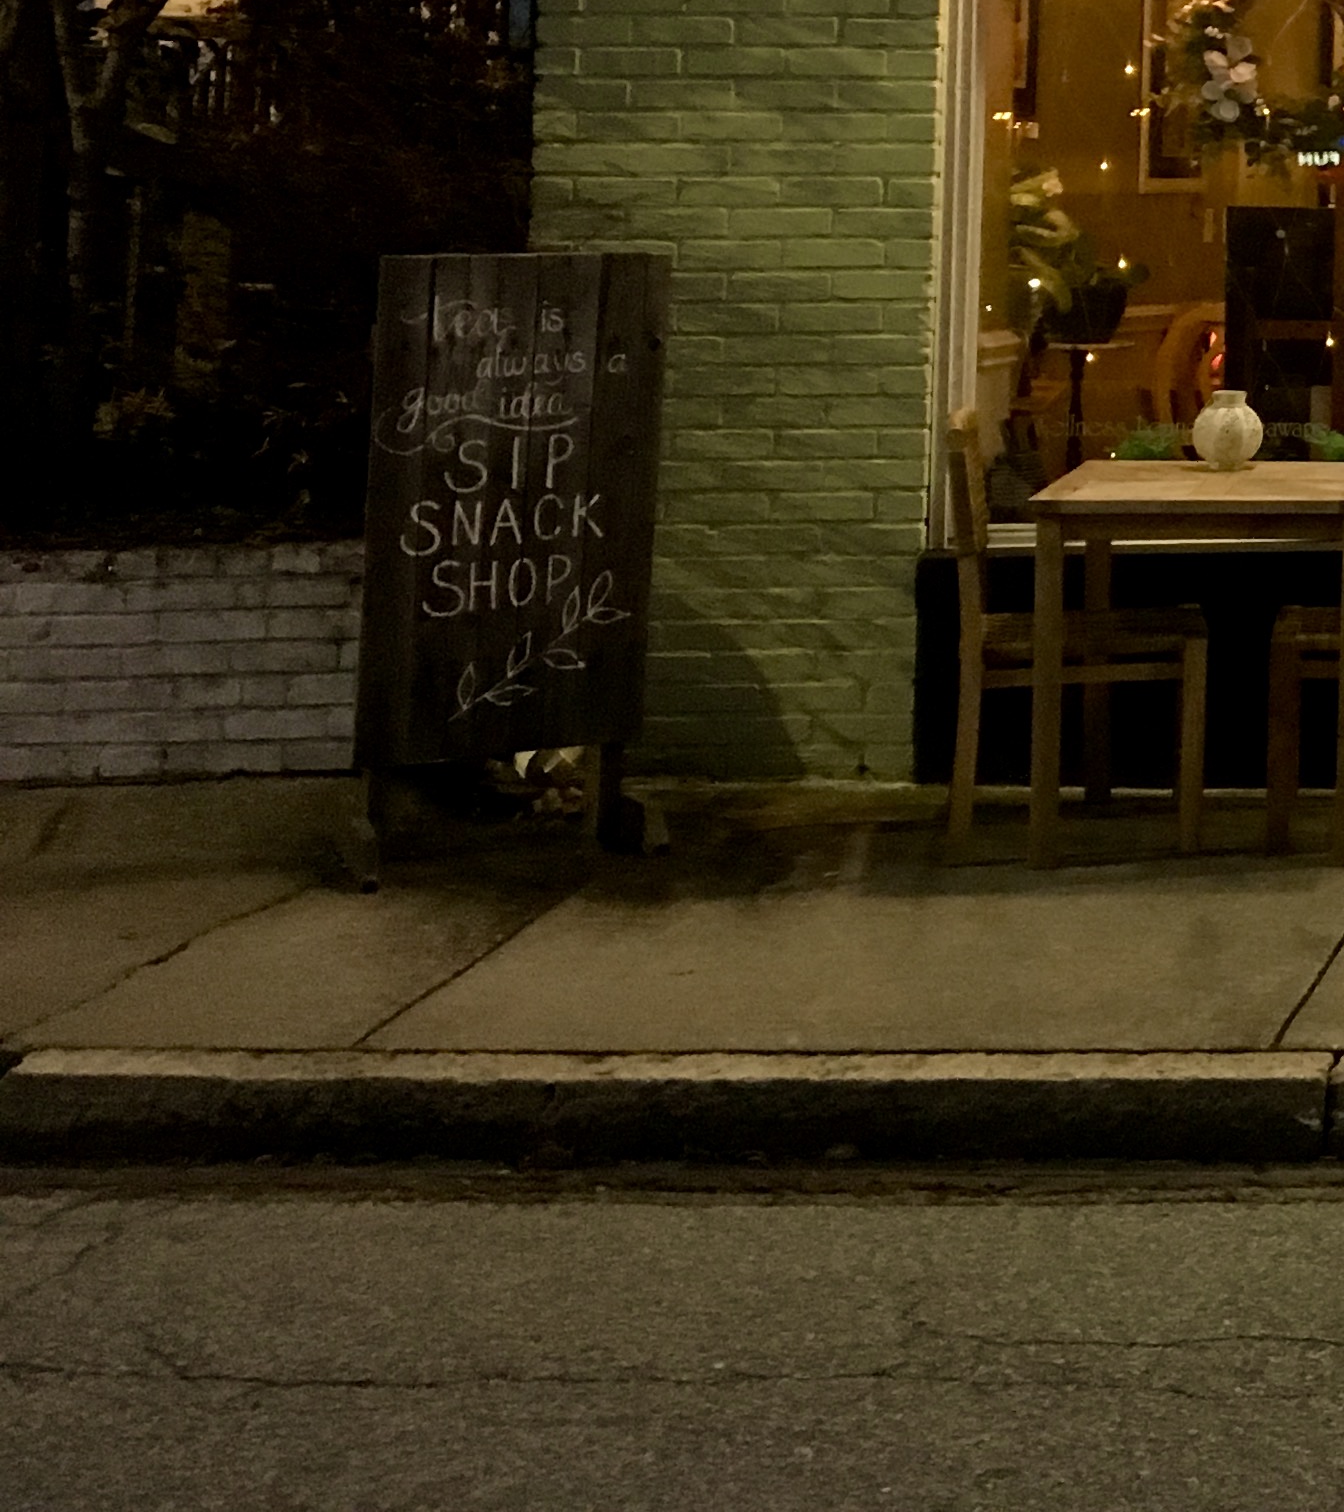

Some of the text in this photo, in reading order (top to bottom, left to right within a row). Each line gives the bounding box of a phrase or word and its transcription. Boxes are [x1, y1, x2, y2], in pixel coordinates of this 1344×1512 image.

[541, 300, 564, 333] is
[476, 345, 628, 386] always a
[397, 381, 574, 433] good idea
[444, 433, 576, 494] SIP
[400, 493, 605, 557] SNACK
[421, 554, 572, 618] SHOP
